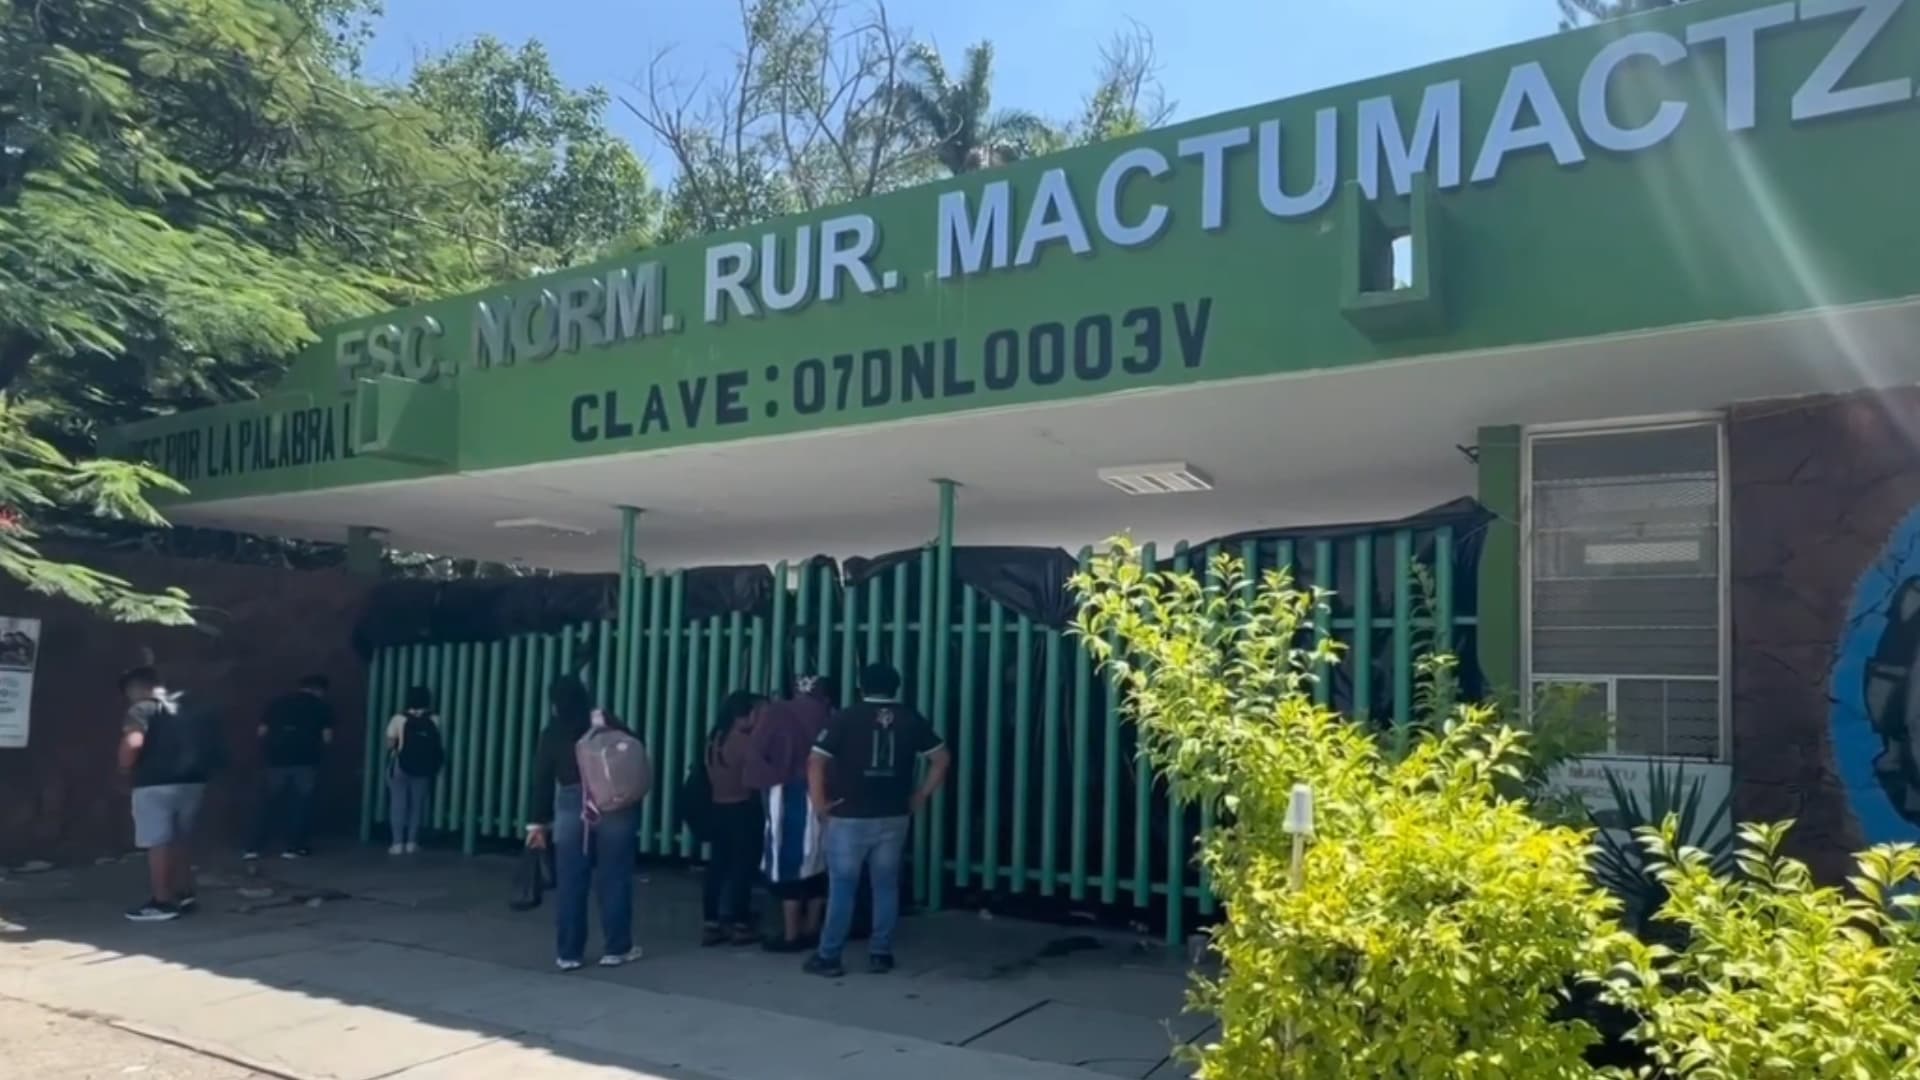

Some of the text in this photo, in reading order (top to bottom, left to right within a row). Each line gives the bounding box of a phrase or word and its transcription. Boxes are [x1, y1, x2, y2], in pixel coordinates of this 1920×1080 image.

[335, 0, 1920, 394] ESC. NORM. RUR. MACTUMACTZ
[165, 430, 200, 481] POR
[207, 424, 233, 477] LA
[238, 405, 336, 475] PALABRA
